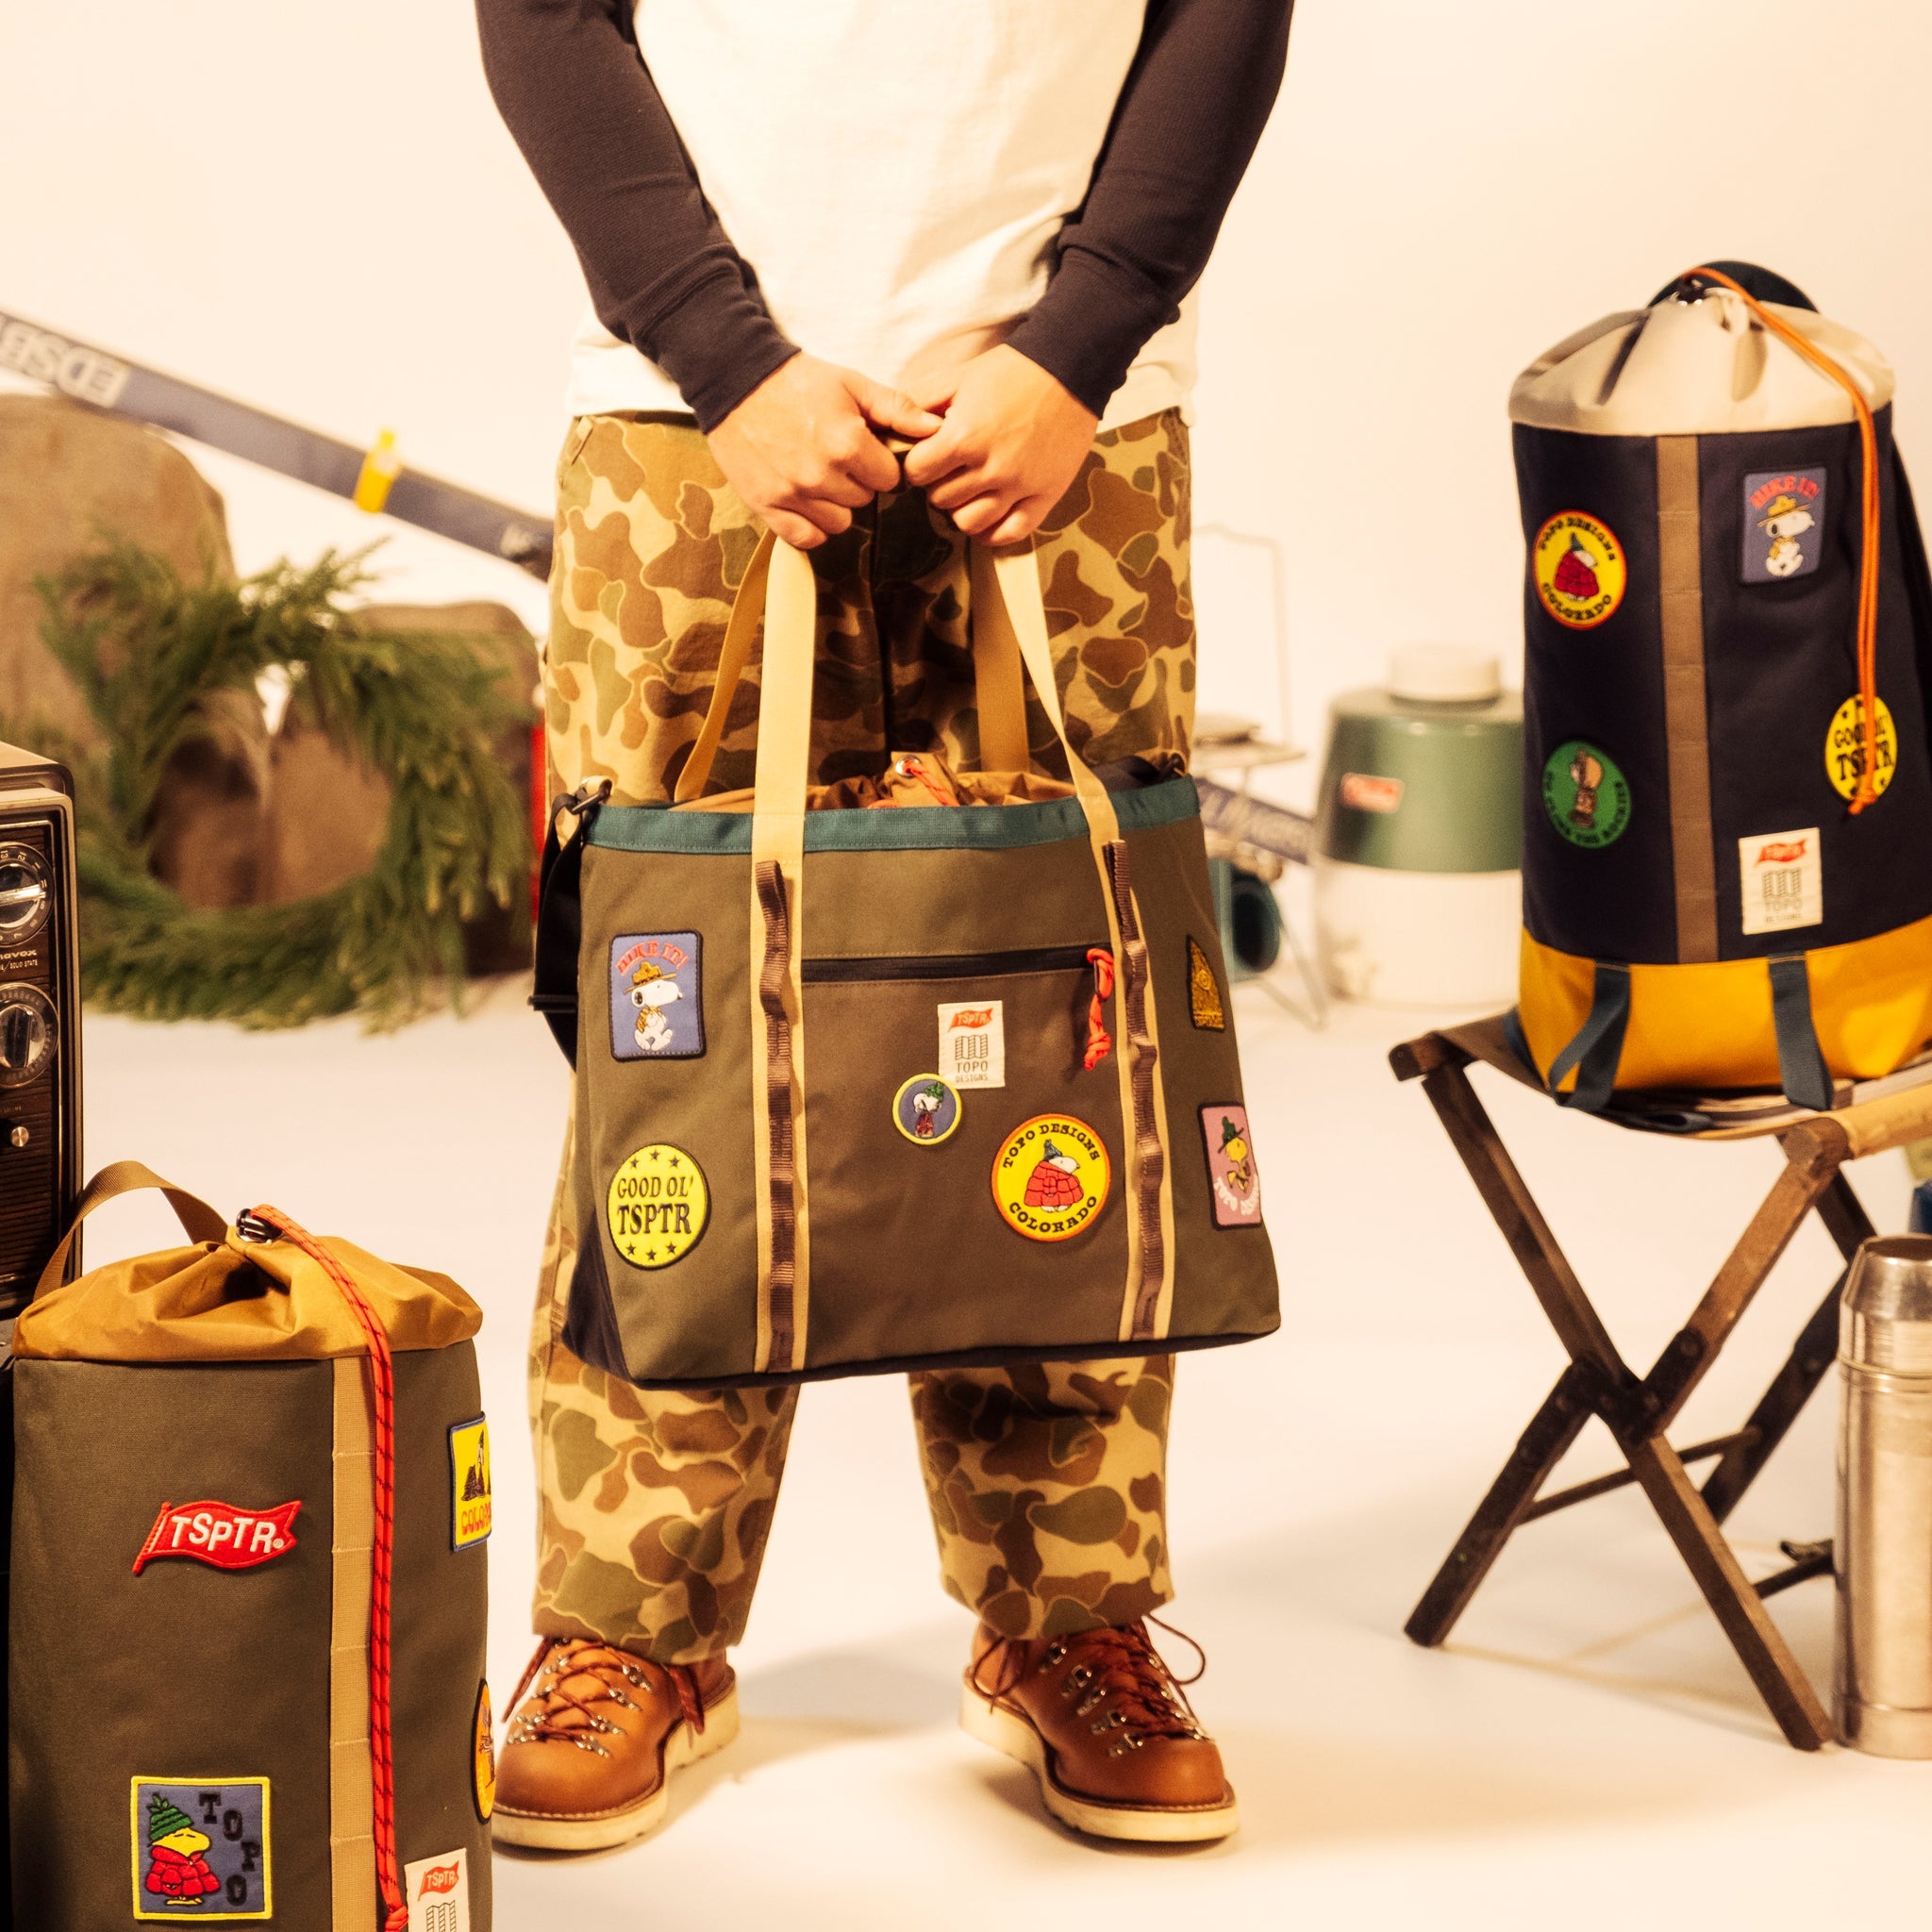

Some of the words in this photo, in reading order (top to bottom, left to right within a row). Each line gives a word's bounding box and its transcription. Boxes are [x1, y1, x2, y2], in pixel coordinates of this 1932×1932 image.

[1541, 582, 1612, 622] COLORADO
[615, 941, 659, 976] HIKE
[955, 1074, 989, 1084] DESIGNS
[956, 1061, 989, 1074] TOPO
[1002, 1130, 1036, 1170] TOPO
[1038, 1123, 1101, 1161] DESIGNS
[617, 1176, 662, 1199] GOOD
[666, 1175, 694, 1198] OL'
[617, 1203, 692, 1235] TSPTR
[1008, 1195, 1098, 1233] COLORADO
[198, 1791, 261, 1907] TOPO
[426, 1870, 457, 1890] TSPTR
